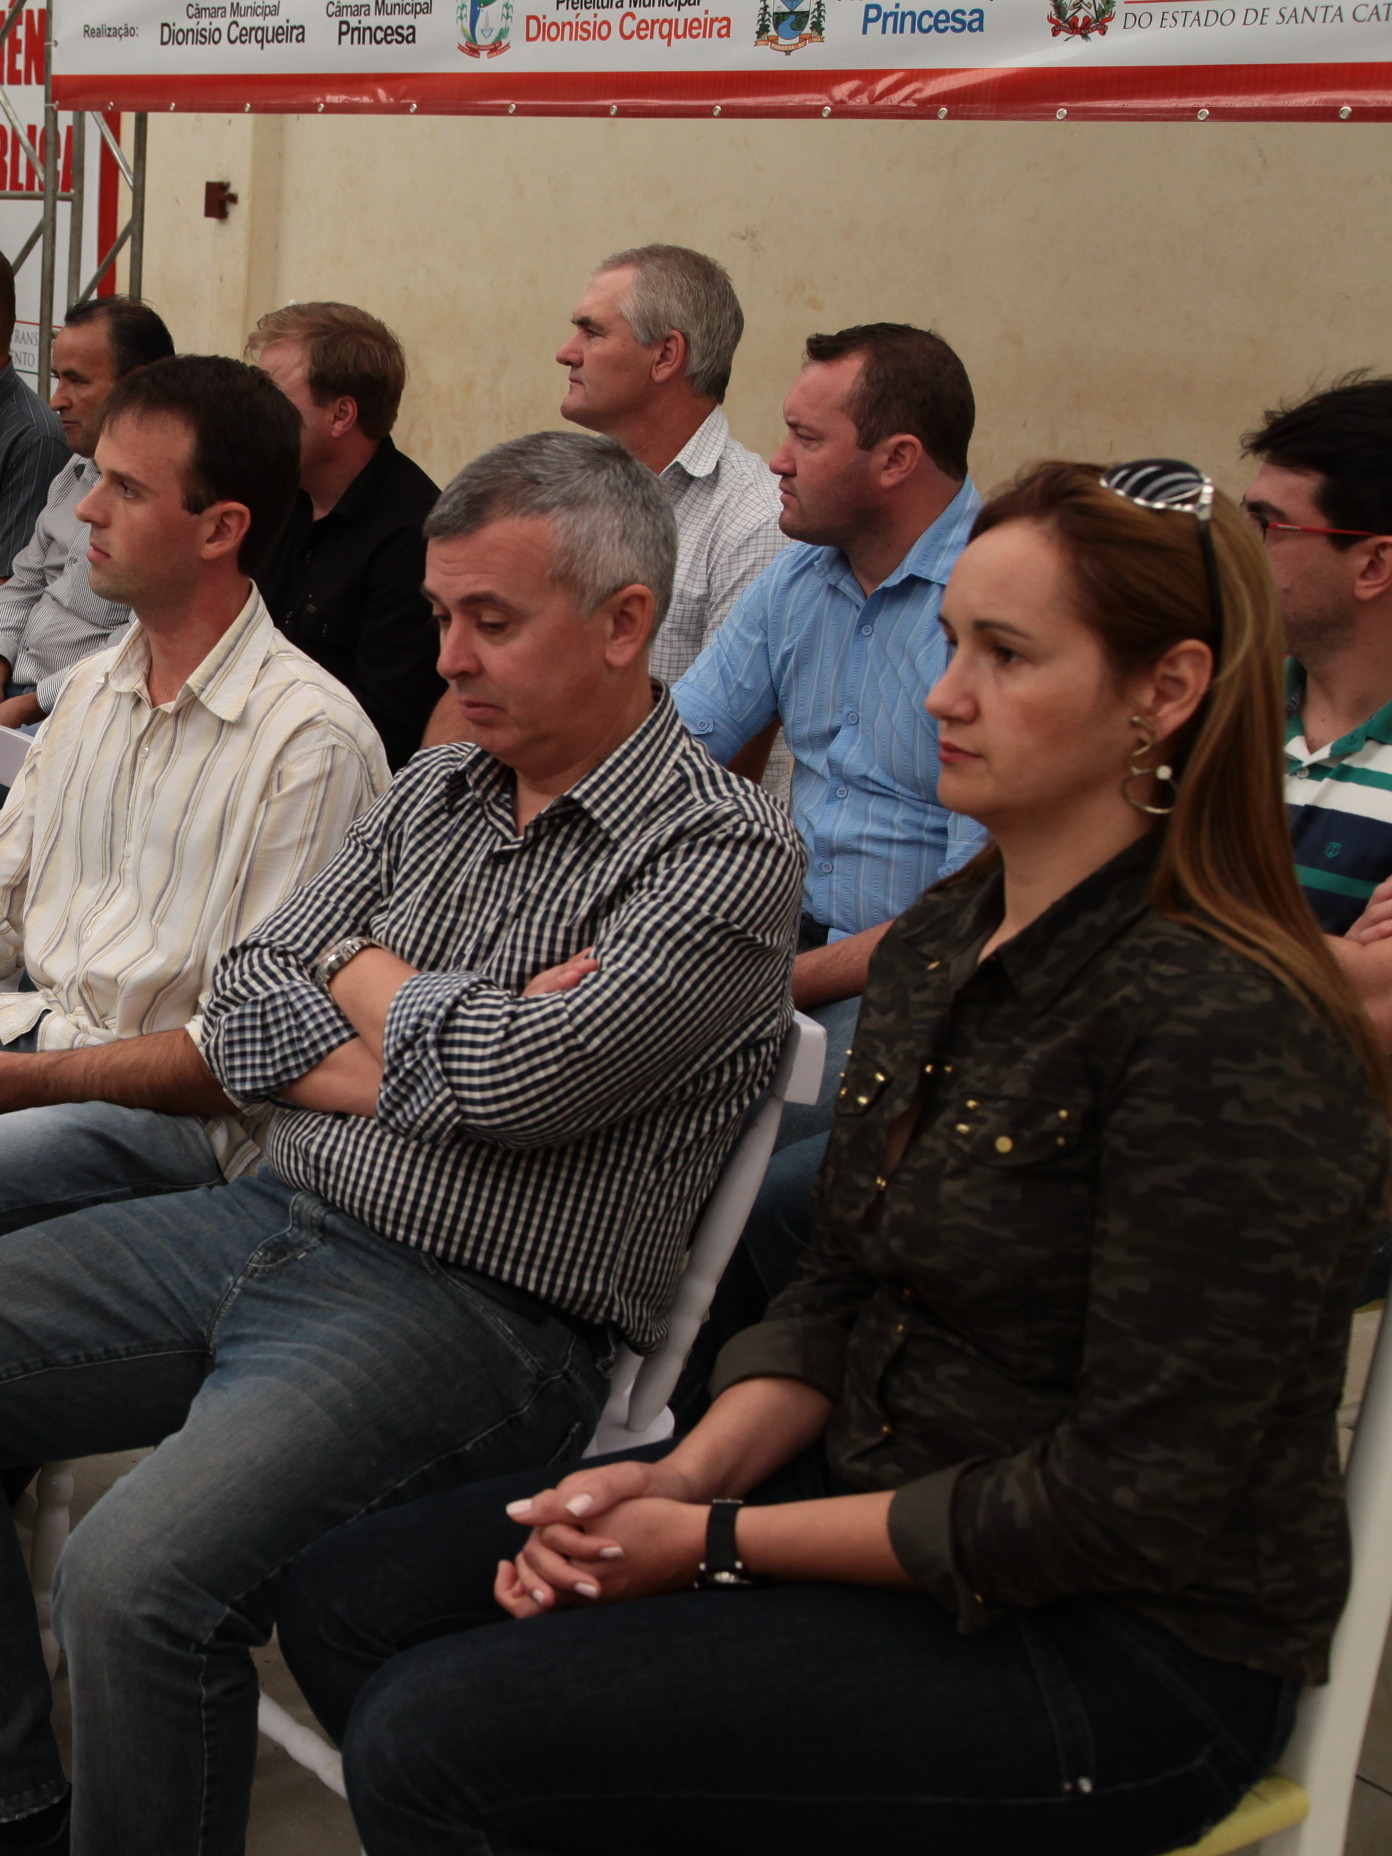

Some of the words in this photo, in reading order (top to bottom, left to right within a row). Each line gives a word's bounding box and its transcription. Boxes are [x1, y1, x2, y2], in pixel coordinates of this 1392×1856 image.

[186, 3, 227, 19] Câmara
[229, 1, 280, 21] Municipal
[326, 1, 371, 18] Câmara
[374, 0, 433, 19] Municipal
[861, 3, 985, 35] Princesa
[1122, 11, 1153, 30] DO
[1158, 8, 1236, 28] ESTADO
[1242, 7, 1271, 26] DE
[1275, 4, 1345, 25] SANTA
[83, 24, 139, 41] Realização:
[160, 21, 222, 46] Dionísio
[226, 19, 306, 50] Cerqueira
[337, 20, 417, 46] Princesa
[525, 14, 612, 42] Dionísio
[618, 10, 732, 47] Cerqueira
